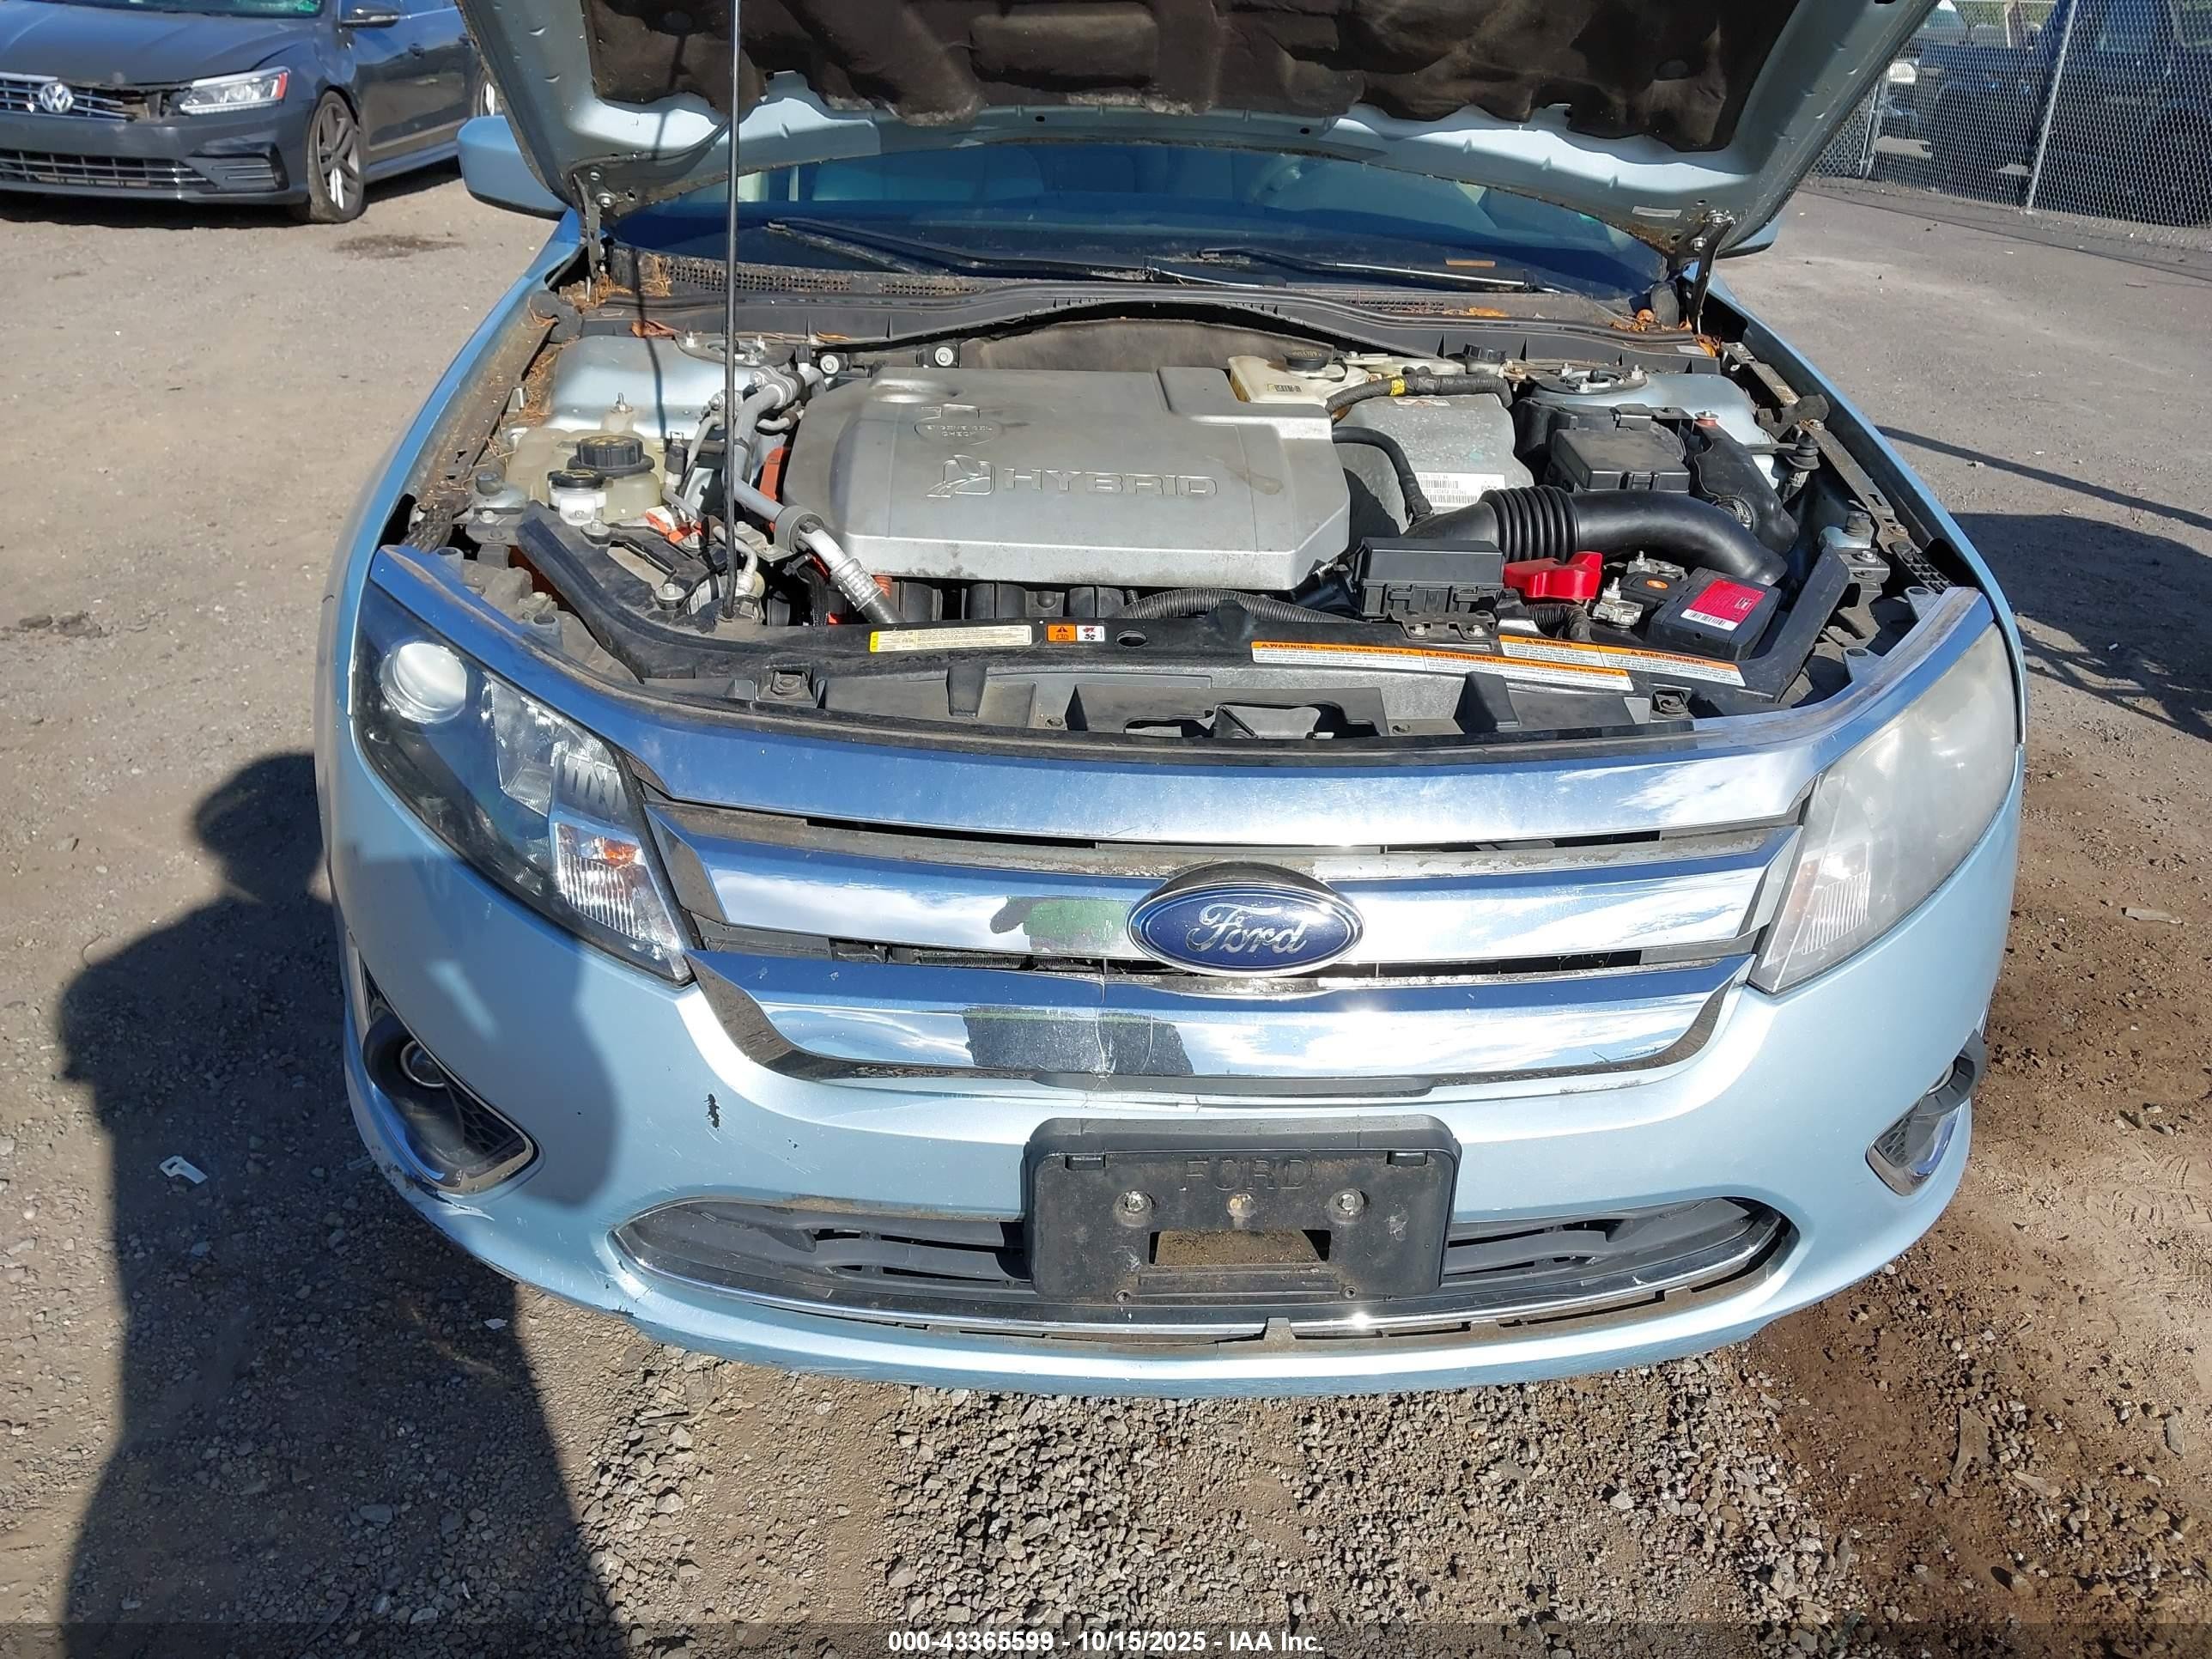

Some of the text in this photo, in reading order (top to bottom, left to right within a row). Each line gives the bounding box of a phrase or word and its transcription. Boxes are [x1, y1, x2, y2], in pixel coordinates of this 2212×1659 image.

[1003, 467, 1218, 495] HYBRID
[1534, 640, 1572, 648] WARNING
[1435, 652, 1496, 663] AVERTISSEMENT
[1640, 652, 1705, 665] AVERTISSEMENT
[1186, 902, 1309, 954] Ford
[1181, 1157, 1314, 1192] FORD
